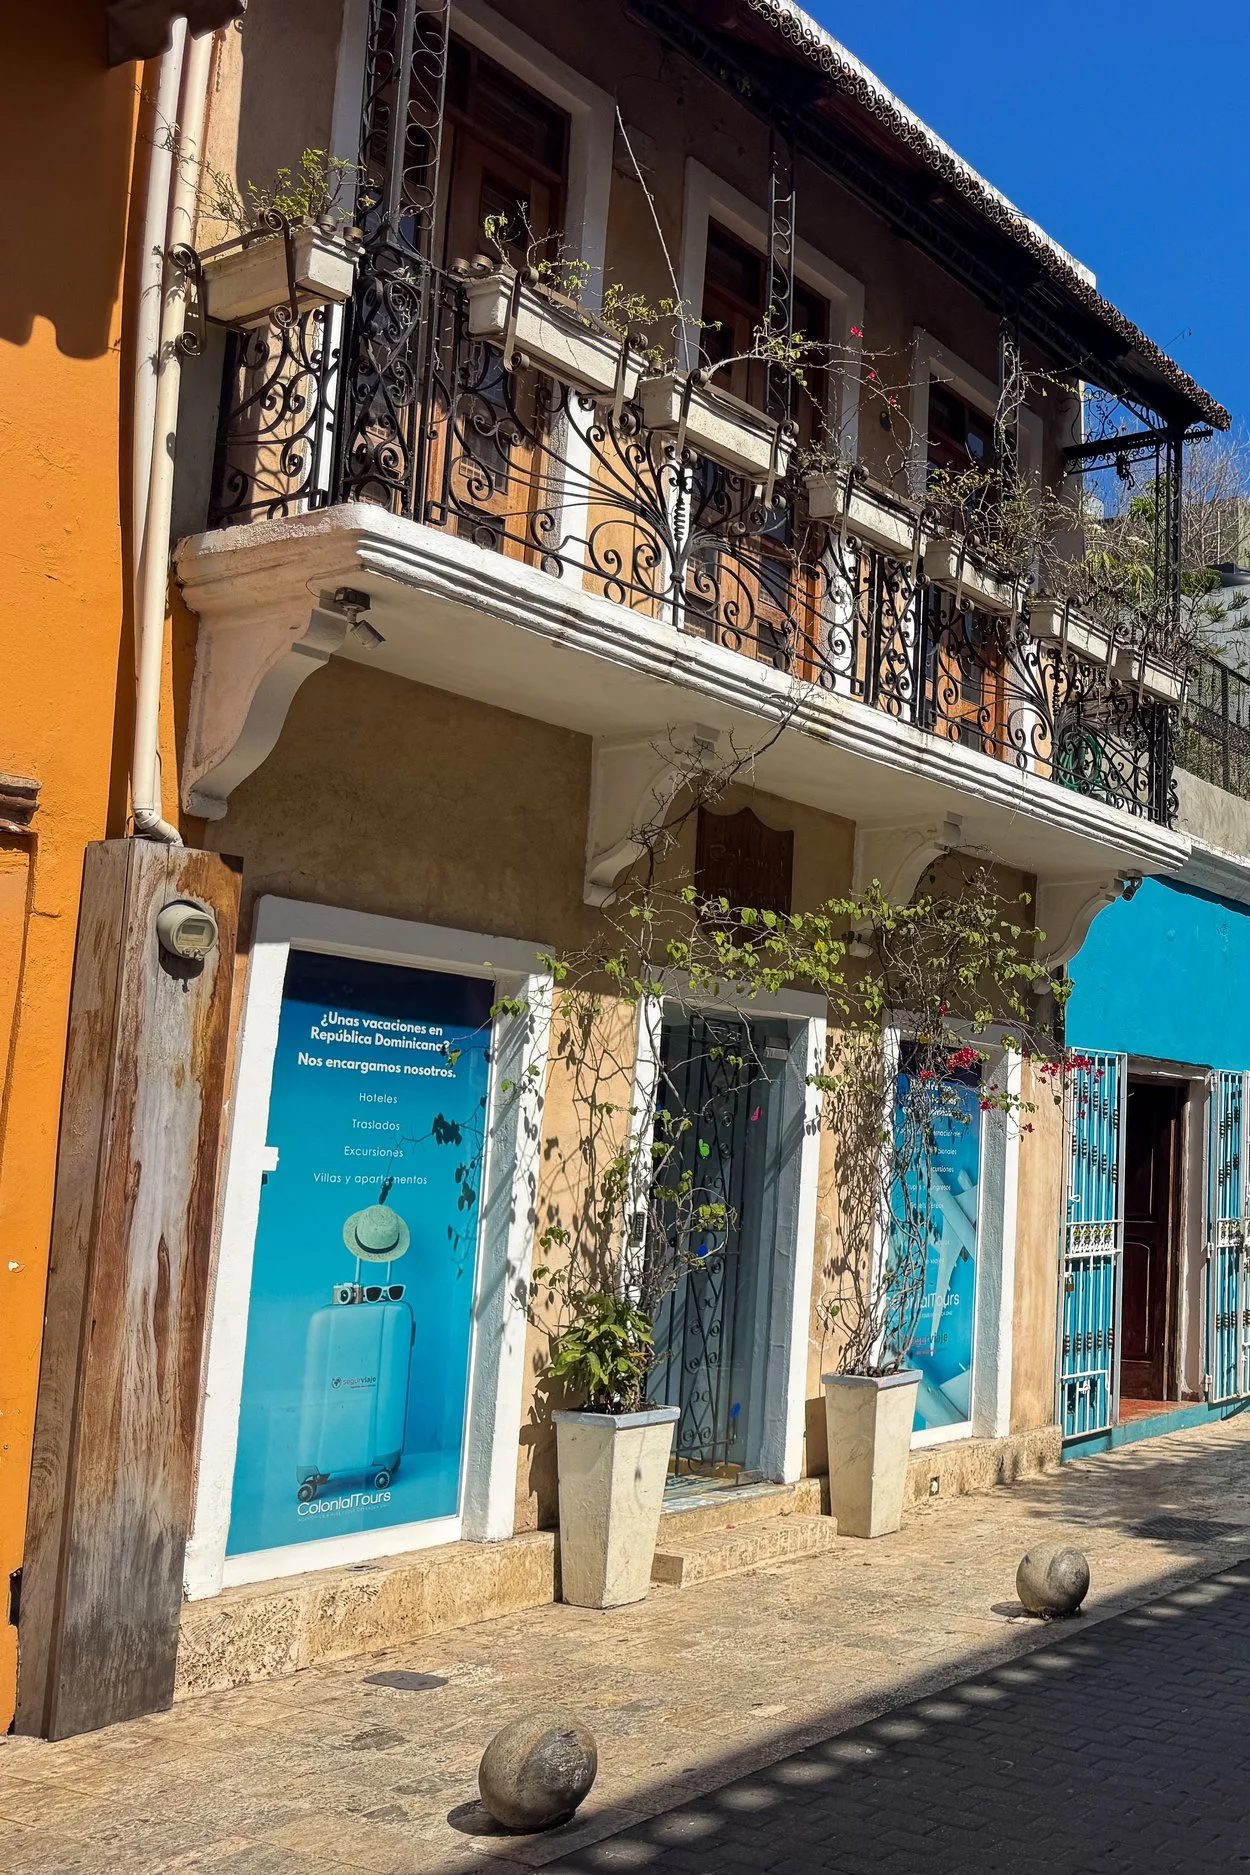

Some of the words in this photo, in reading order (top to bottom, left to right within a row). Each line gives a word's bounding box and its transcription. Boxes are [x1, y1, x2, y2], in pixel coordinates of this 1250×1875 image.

[320, 1011, 359, 1028] ¿Unas
[362, 1017, 426, 1035] vacaciones
[429, 1025, 443, 1036] en
[311, 1027, 372, 1046] República
[375, 1034, 451, 1051] Dominicana?
[298, 1052, 322, 1067] Nos
[325, 1058, 401, 1076] encargamos
[403, 1063, 457, 1078] nosotros.
[359, 1093, 398, 1104] Hoteles
[352, 1119, 400, 1131] Traslados
[344, 1146, 404, 1158] Excursiones
[313, 1173, 342, 1184] Villas
[344, 1176, 351, 1185] y
[354, 1174, 428, 1186] apartamentos
[297, 1492, 391, 1516] ColonialTours
